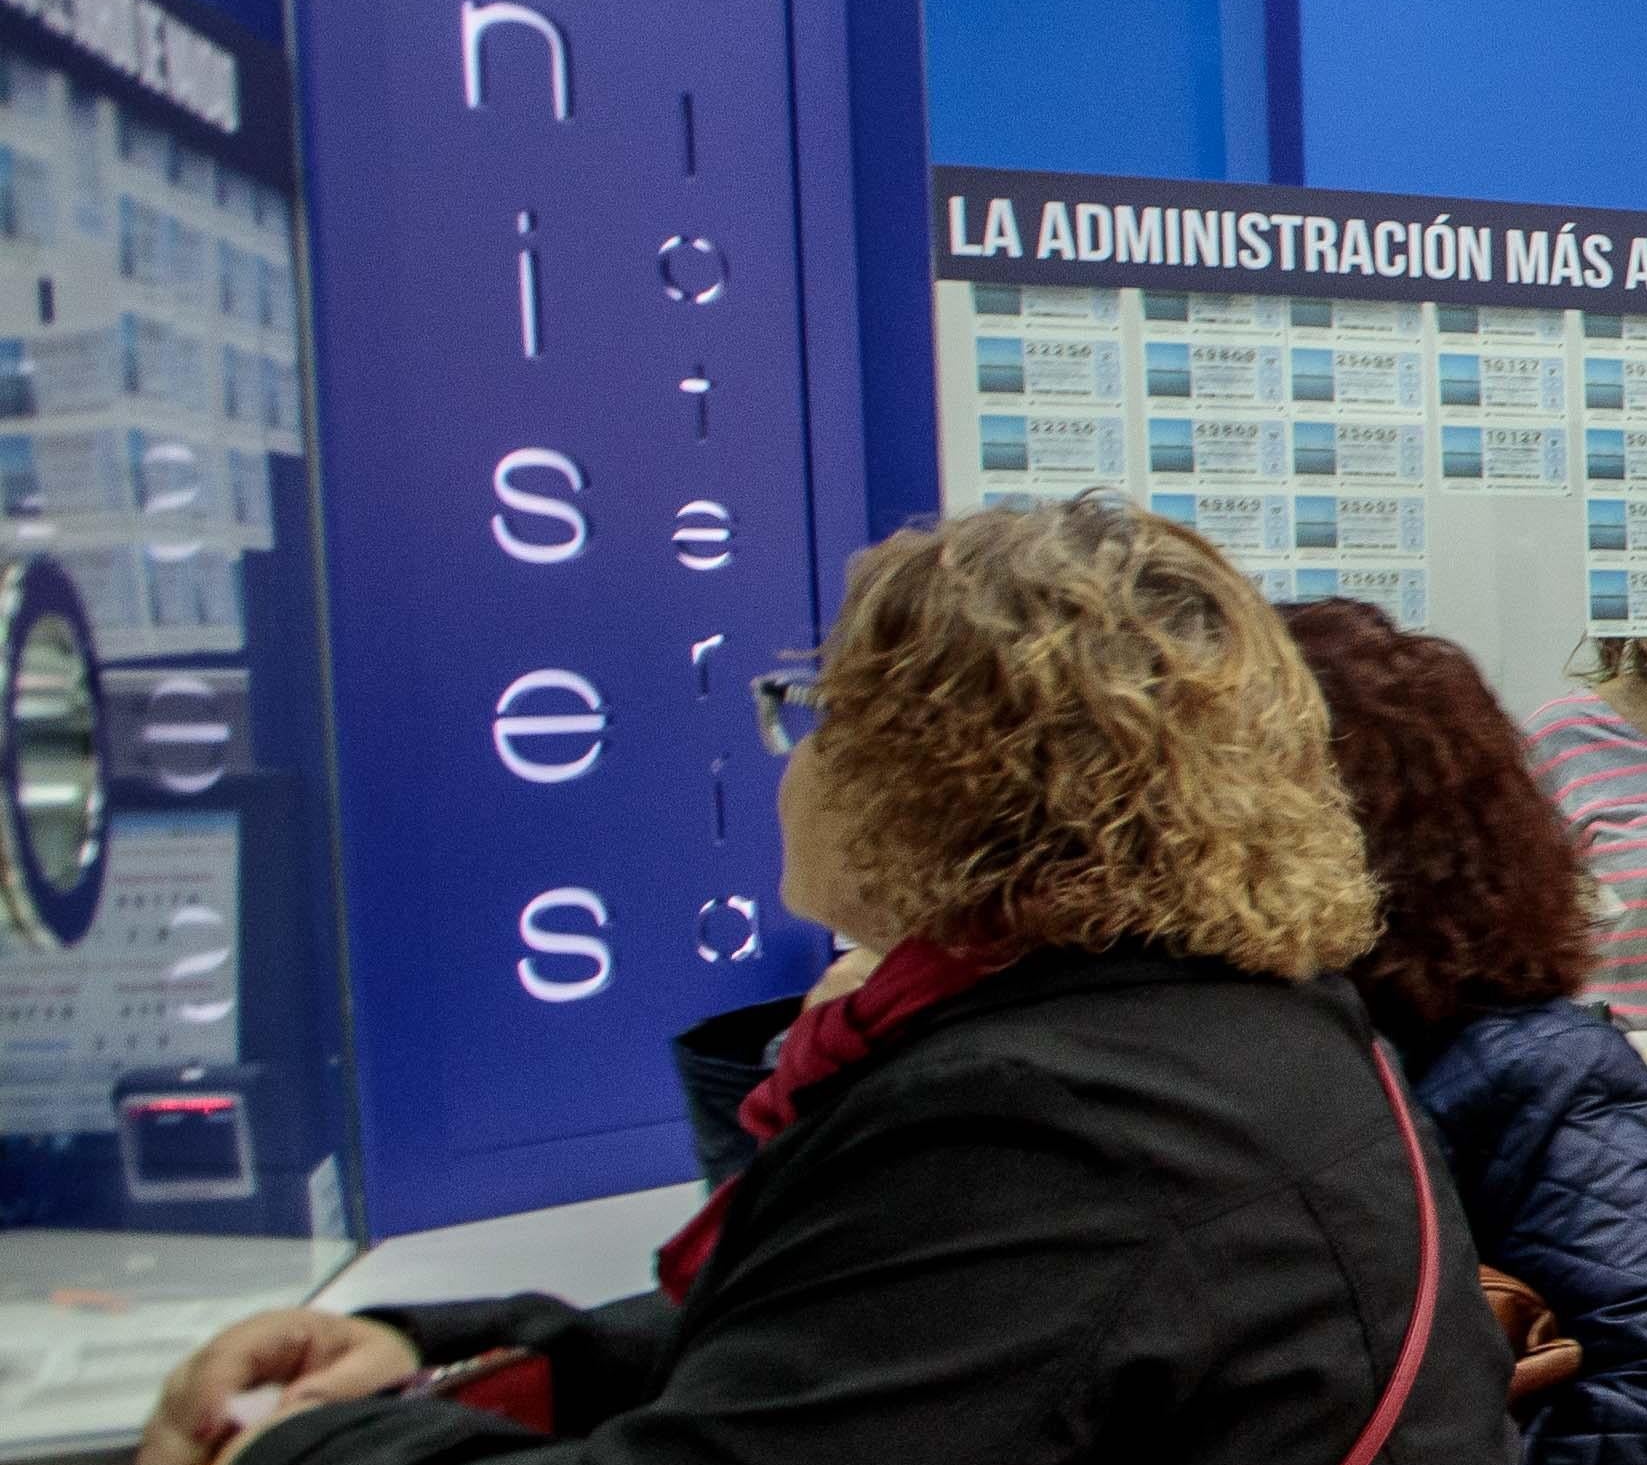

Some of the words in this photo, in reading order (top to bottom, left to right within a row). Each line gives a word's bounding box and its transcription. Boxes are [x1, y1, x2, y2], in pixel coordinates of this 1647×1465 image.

[947, 195, 1023, 259] LA
[1036, 200, 1493, 284] ADMINISTRACIÓN
[1506, 222, 1614, 291] MÁS
